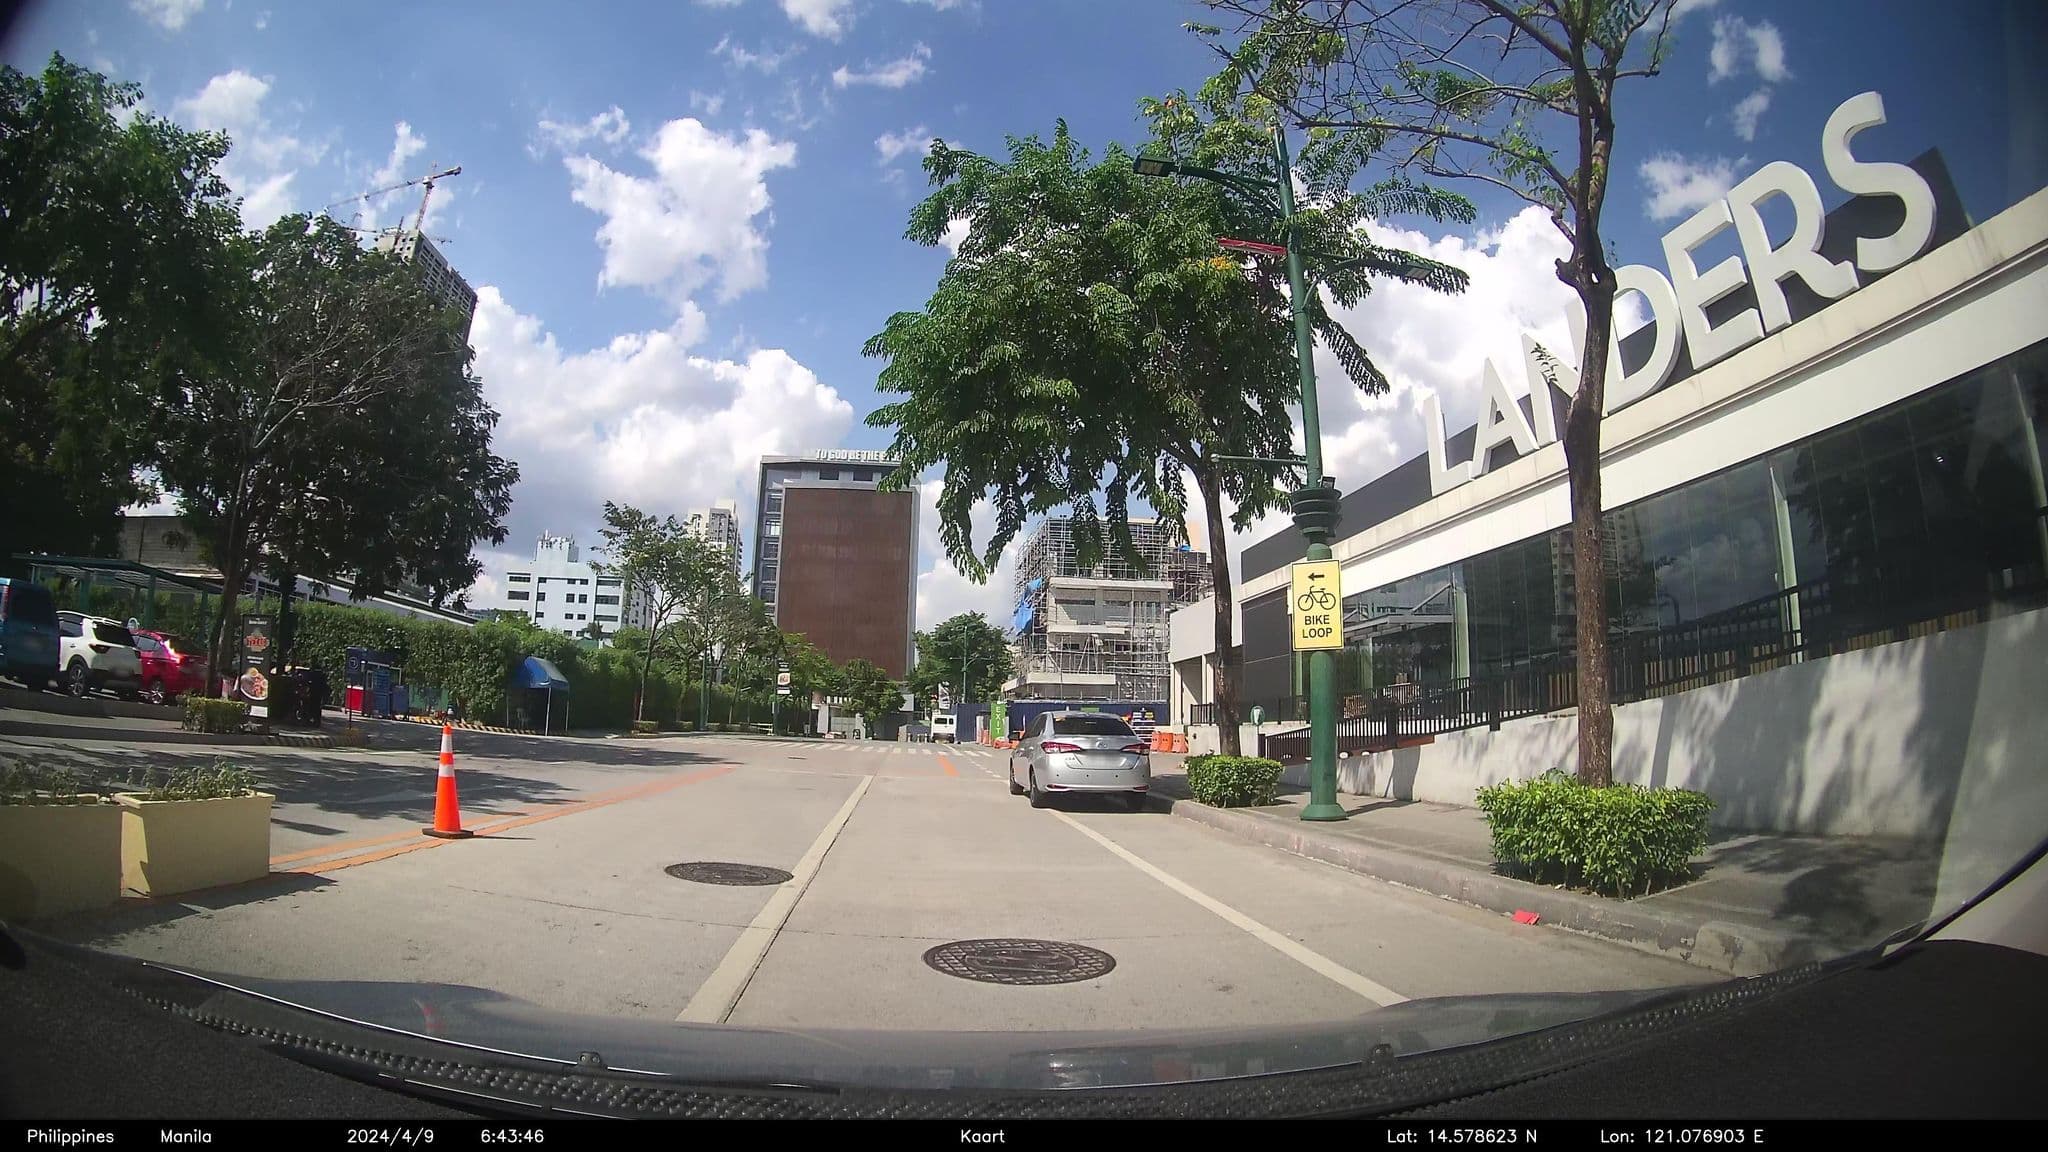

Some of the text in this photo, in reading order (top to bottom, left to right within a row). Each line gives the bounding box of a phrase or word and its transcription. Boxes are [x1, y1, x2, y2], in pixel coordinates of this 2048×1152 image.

[1425, 91, 1938, 497] LANDERS
[828, 449, 848, 461] GOD
[861, 450, 879, 461] THE
[1304, 614, 1330, 626] BIKE
[1302, 627, 1333, 639] LOOP
